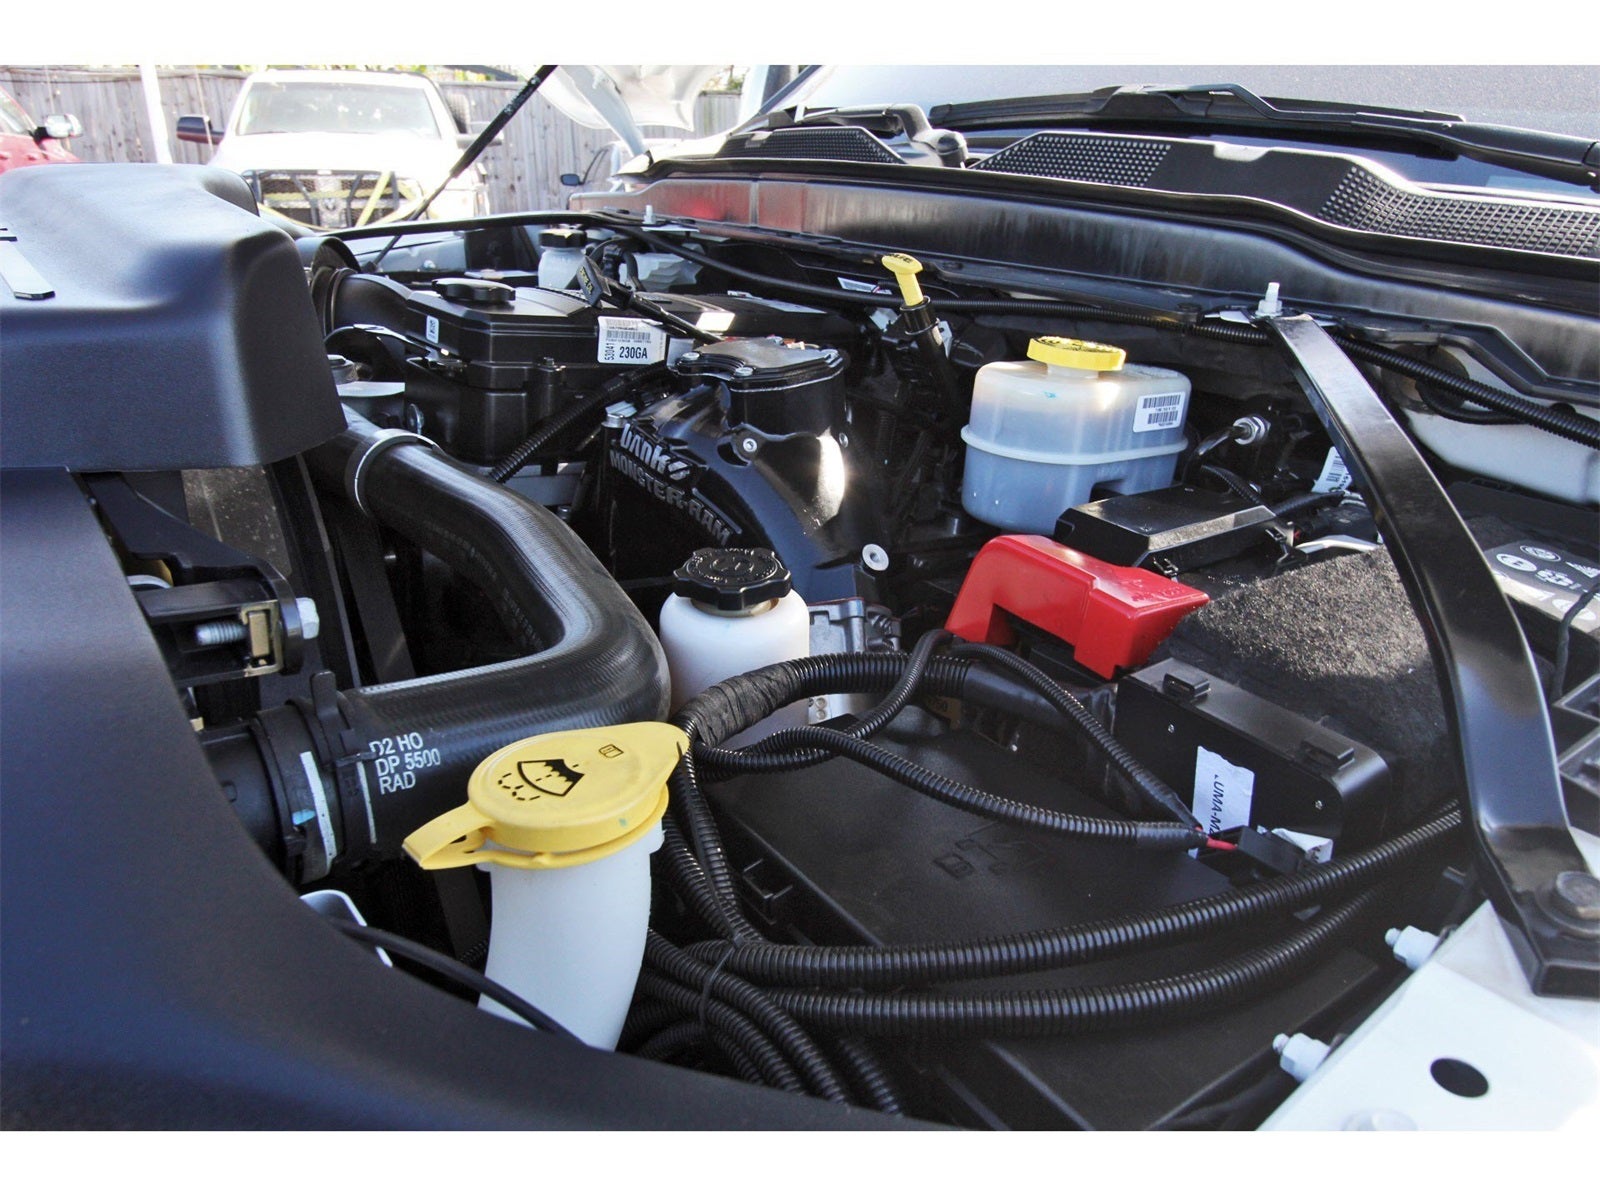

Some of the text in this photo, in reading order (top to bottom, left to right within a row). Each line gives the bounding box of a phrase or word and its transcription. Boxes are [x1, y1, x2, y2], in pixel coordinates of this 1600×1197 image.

[619, 346, 648, 359] 230GA
[368, 732, 423, 756] D2 HO
[374, 748, 441, 777] DP 5500
[378, 771, 416, 794] RAD
